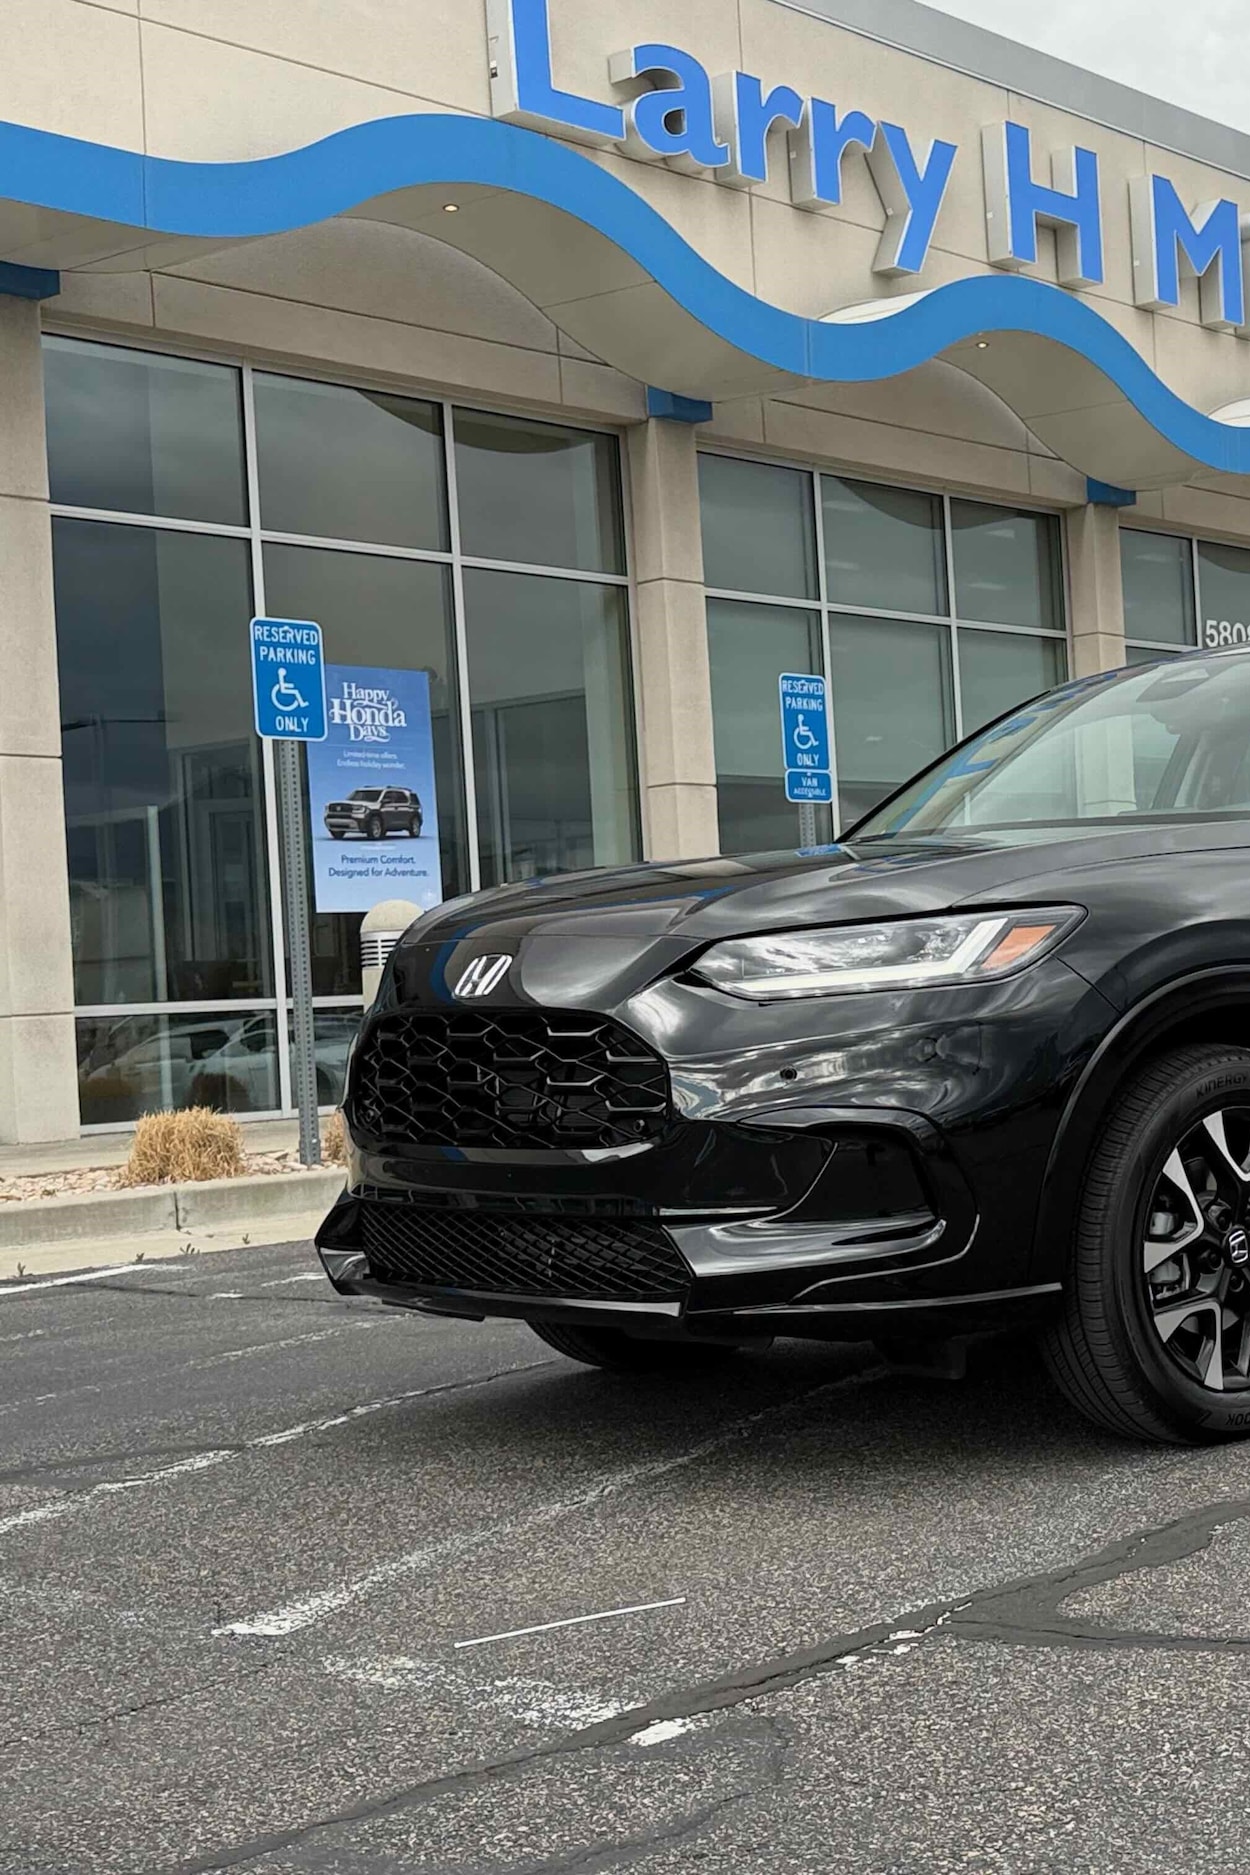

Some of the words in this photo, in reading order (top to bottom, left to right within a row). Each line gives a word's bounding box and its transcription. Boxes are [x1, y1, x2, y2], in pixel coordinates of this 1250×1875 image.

[511, 0, 958, 274] Larry
[1003, 120, 1103, 284] H
[254, 625, 319, 646] RESERVED
[259, 646, 316, 665] PARKING
[342, 681, 390, 704] Happy
[782, 680, 823, 695] RESERVED
[785, 697, 823, 711] PARKING
[328, 698, 408, 728] Honda
[275, 715, 309, 732] ONLY
[797, 753, 819, 766] ONLY
[801, 777, 818, 788] VAN
[341, 854, 378, 864] Premium
[328, 867, 370, 879] Designed
[371, 867, 383, 877] for
